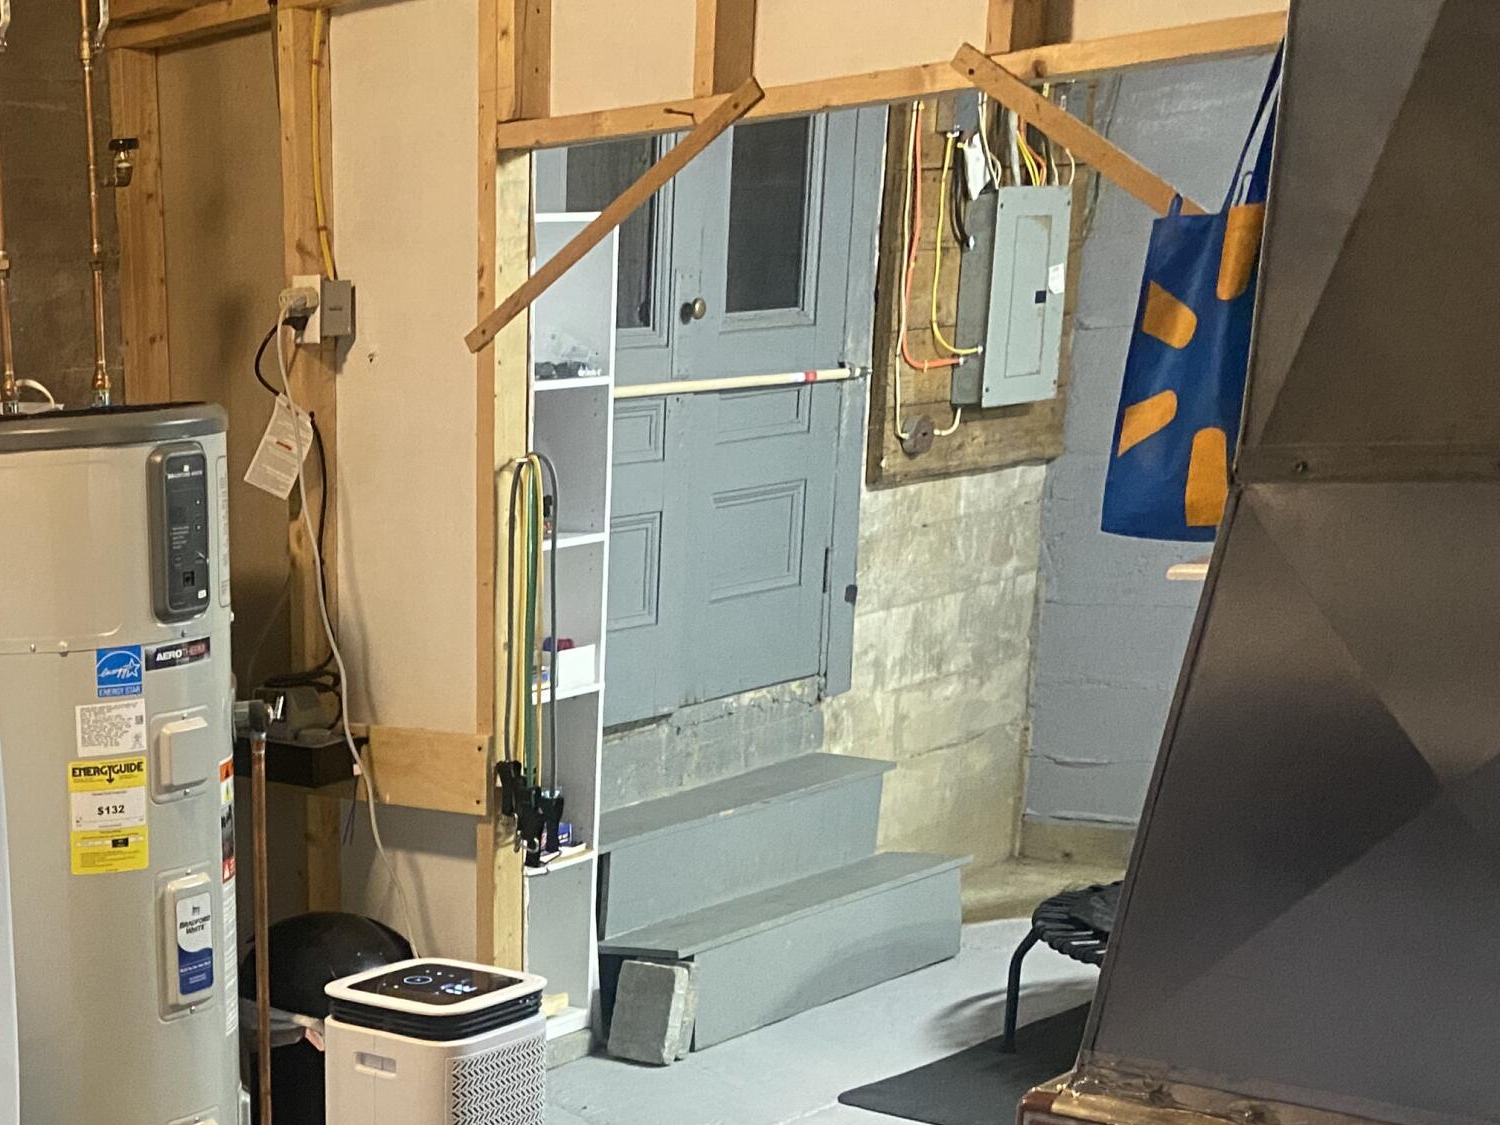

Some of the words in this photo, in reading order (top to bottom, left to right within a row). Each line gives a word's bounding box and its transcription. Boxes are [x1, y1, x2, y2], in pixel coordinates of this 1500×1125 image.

[98, 687, 125, 697] ENERGY
[125, 686, 141, 695] STAR
[72, 762, 144, 779] ENERGYGUIDE
[96, 804, 125, 816] $132
[179, 914, 211, 930] BRADFORD
[185, 923, 205, 935] WHITE
